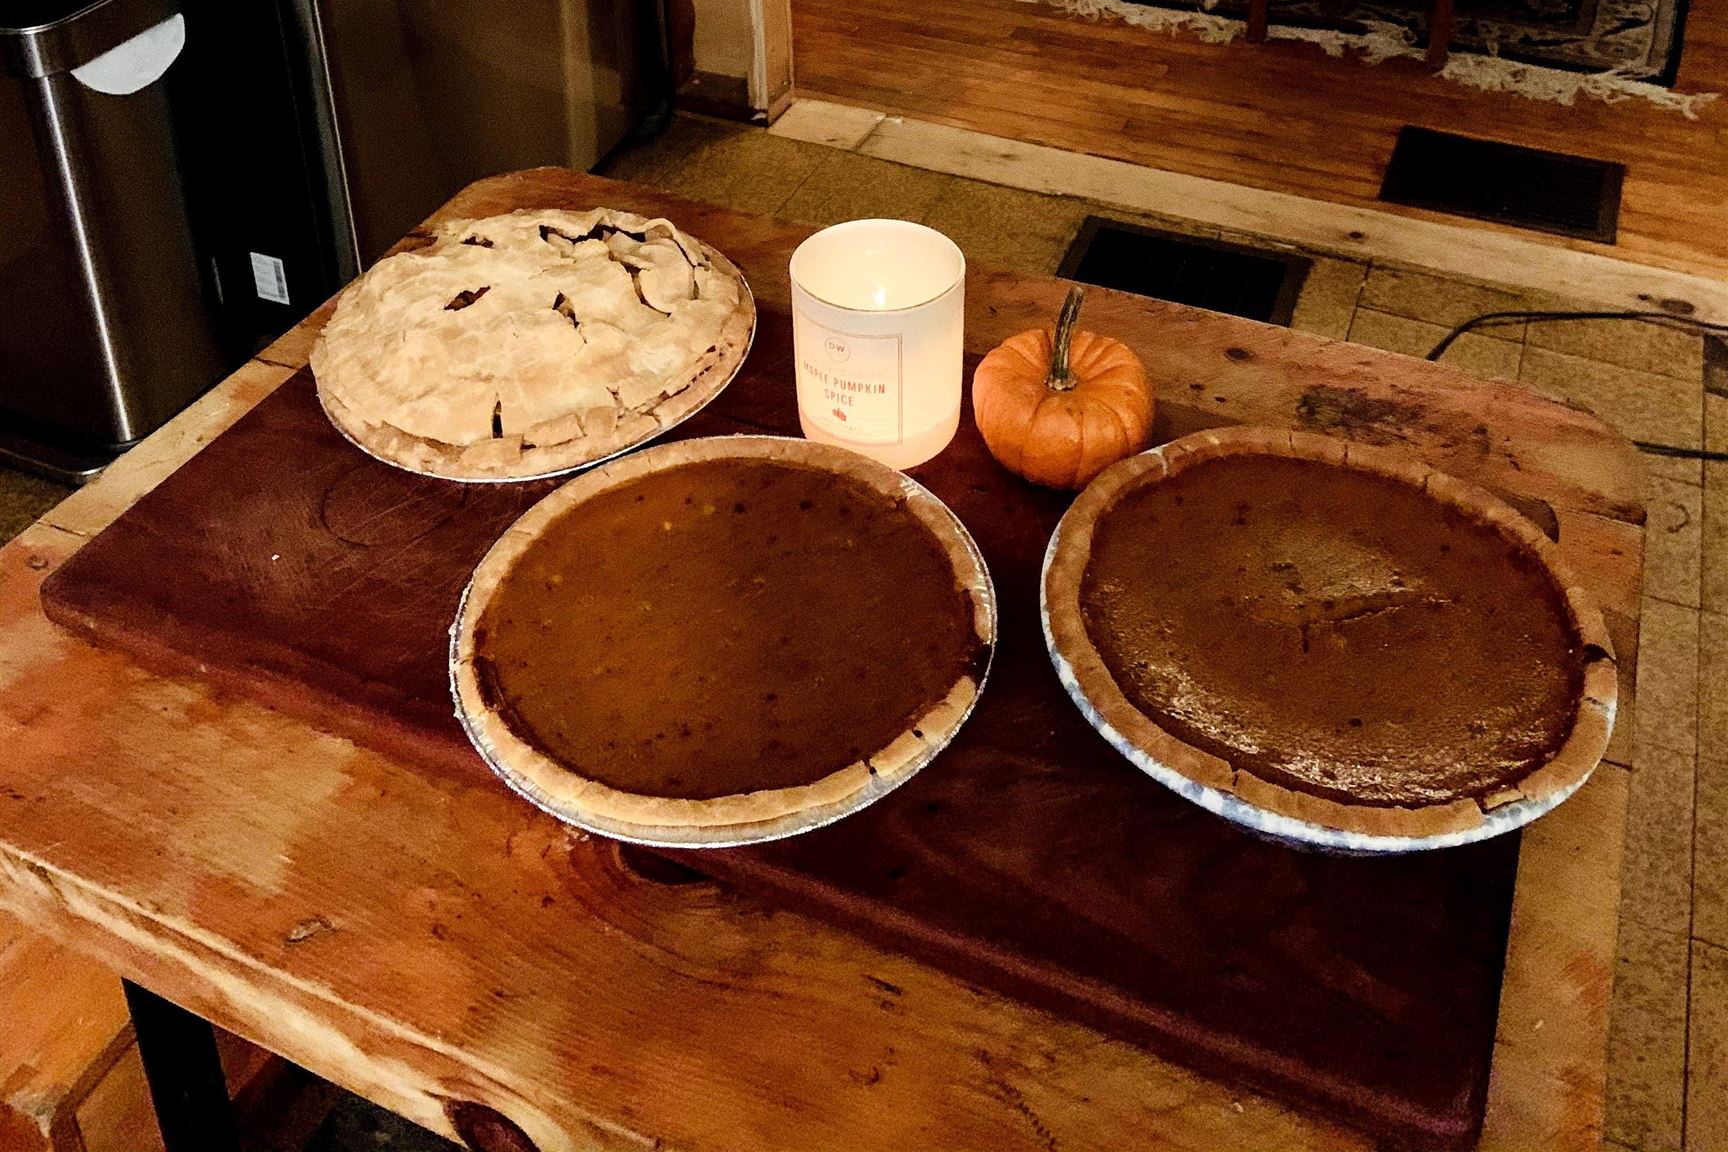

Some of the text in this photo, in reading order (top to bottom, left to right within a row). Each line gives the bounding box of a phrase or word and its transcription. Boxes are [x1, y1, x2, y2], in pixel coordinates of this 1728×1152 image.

[828, 341, 845, 352] DW
[803, 359, 828, 384] MAPLE
[833, 376, 886, 394] PUMPKIN
[824, 388, 854, 407] SPICE
